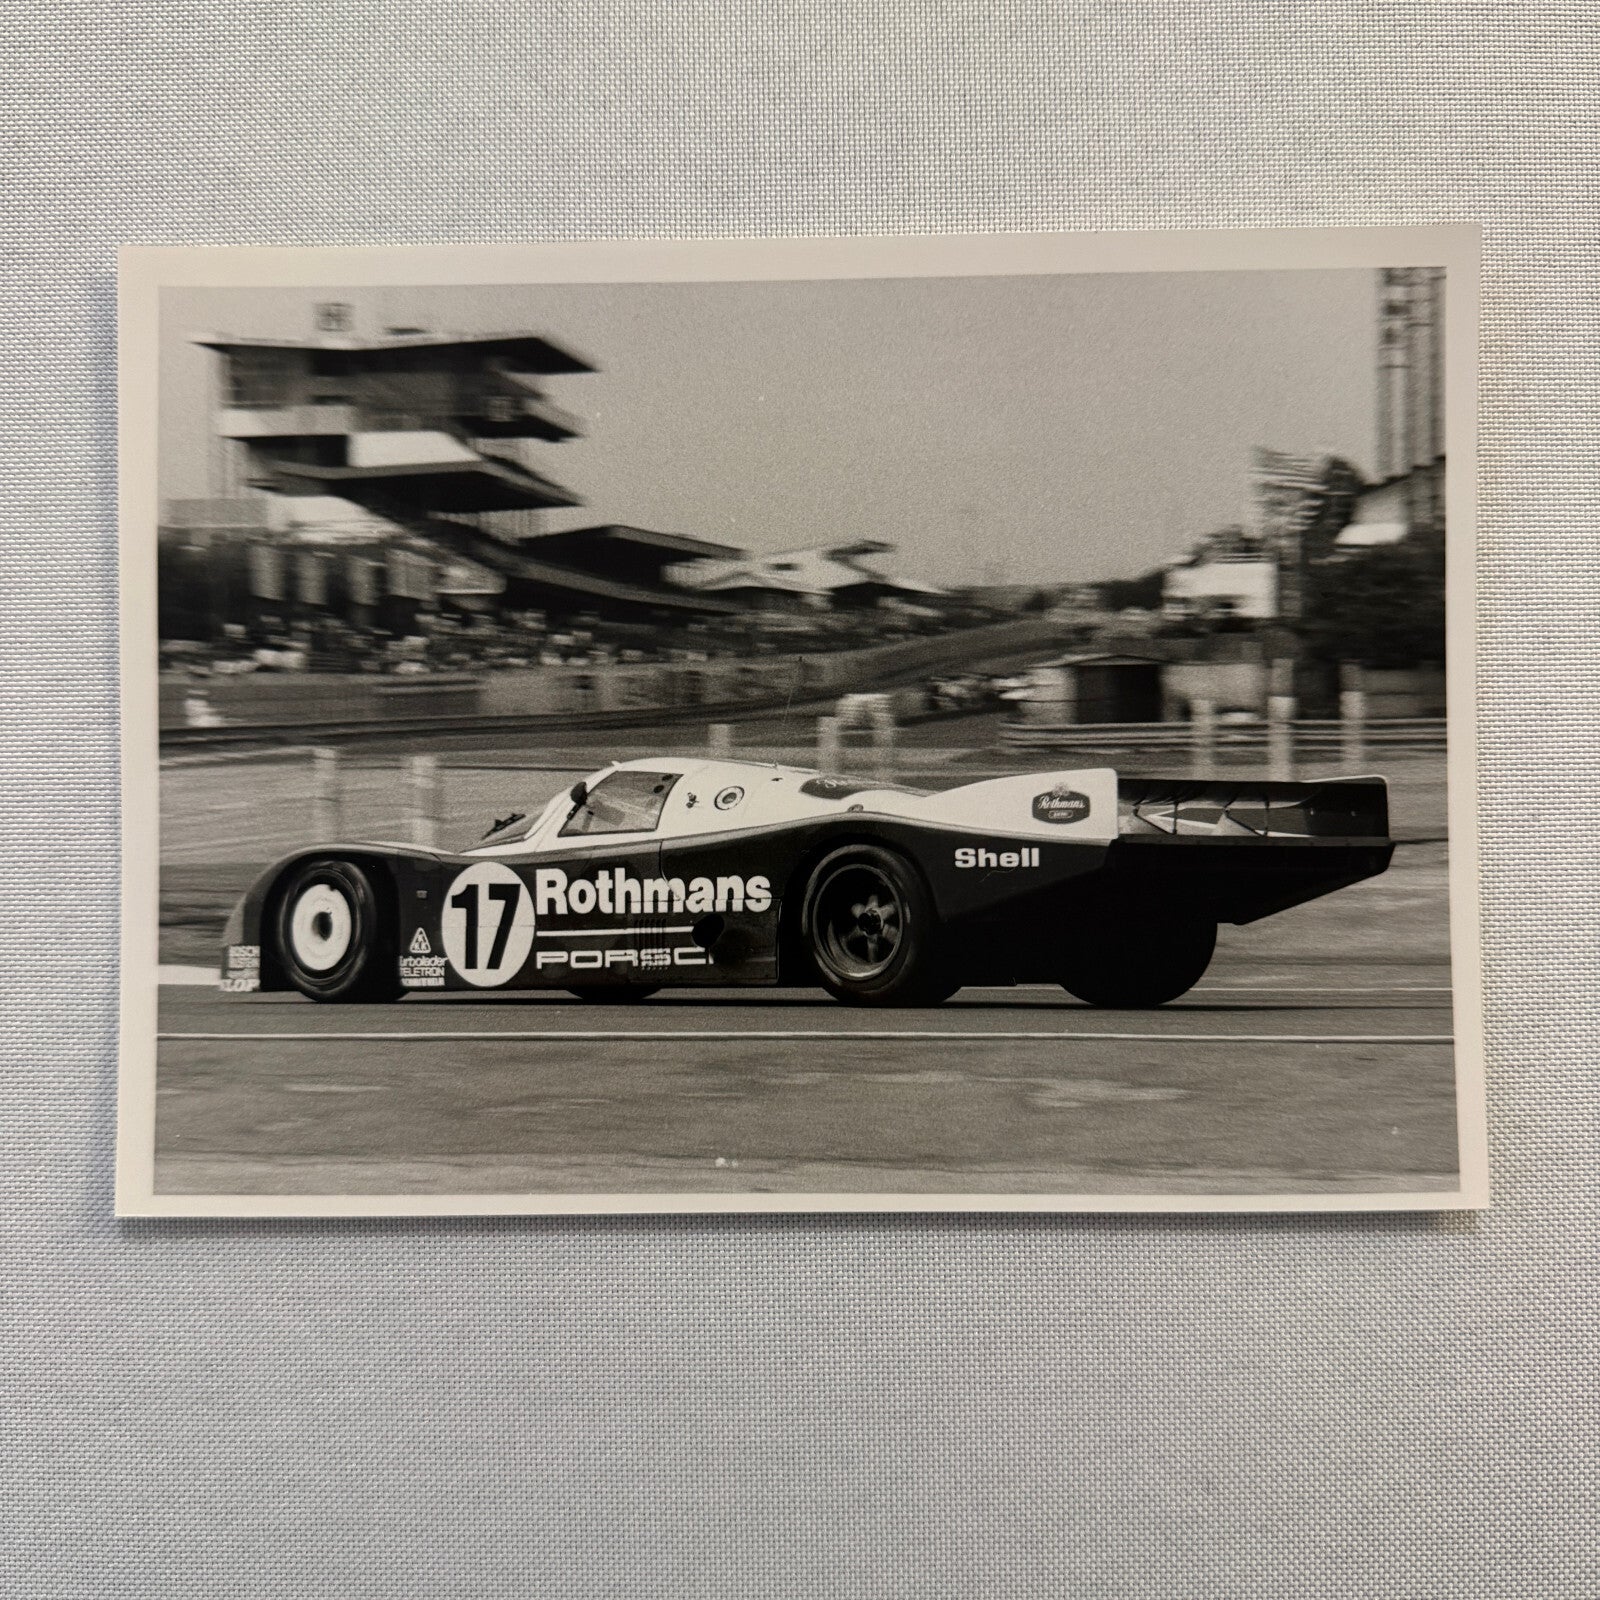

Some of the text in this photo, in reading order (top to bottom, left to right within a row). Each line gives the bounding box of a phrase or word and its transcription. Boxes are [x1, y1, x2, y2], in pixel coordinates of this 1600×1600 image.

[1037, 795, 1086, 809] Rothmans
[954, 847, 1039, 868] Shell
[536, 868, 772, 915] Rothmans
[451, 883, 522, 970] 17
